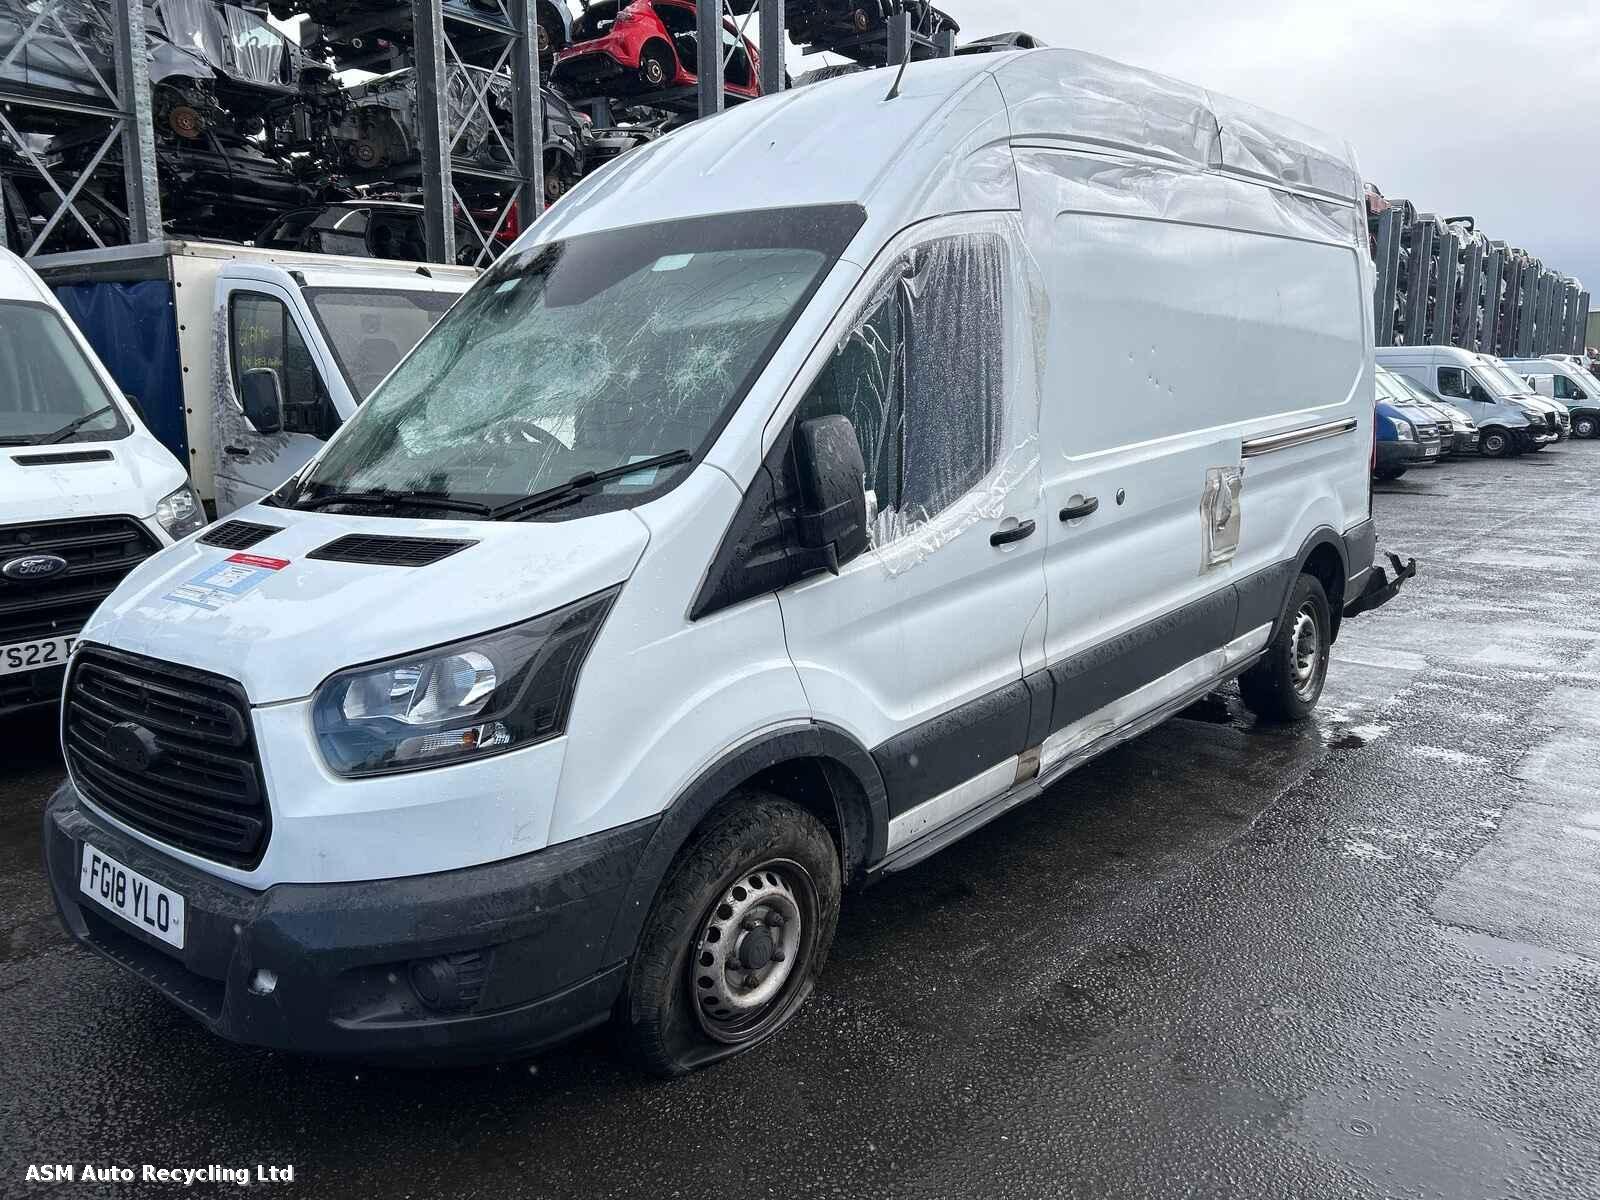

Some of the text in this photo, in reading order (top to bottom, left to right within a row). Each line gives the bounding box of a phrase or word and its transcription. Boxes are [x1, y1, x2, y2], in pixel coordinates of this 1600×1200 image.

[20, 559, 53, 573] Ford
[0, 641, 58, 668] S22
[90, 854, 170, 932] FG18 YLO
